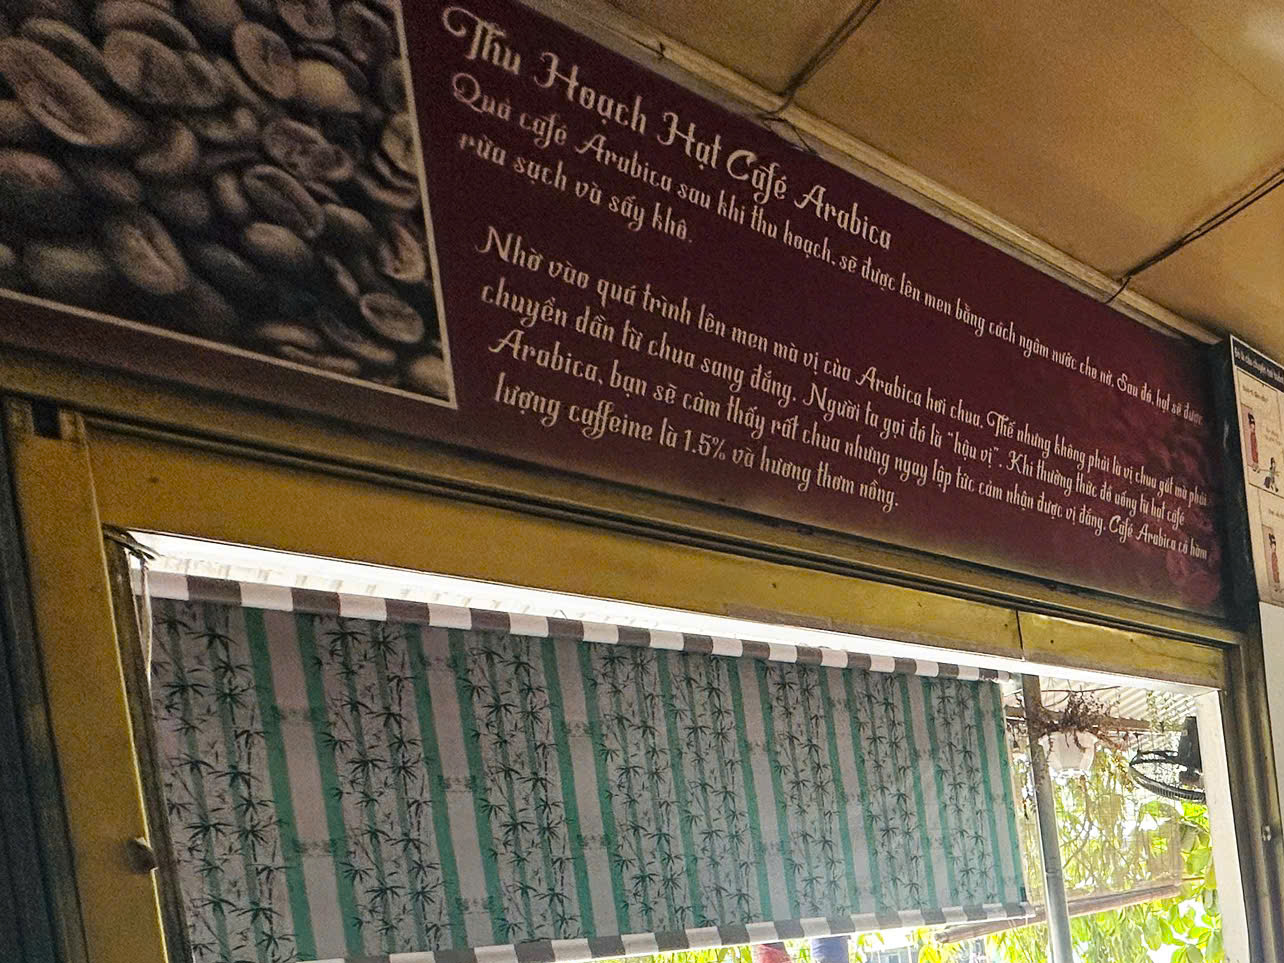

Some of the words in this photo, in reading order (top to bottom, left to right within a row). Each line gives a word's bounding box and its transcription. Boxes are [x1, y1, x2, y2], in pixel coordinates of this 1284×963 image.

[441, 5, 521, 76] Thu
[533, 51, 647, 135] Hoạch
[656, 111, 722, 170] Hạt
[726, 149, 787, 205] Café
[793, 184, 892, 250] Arabica
[451, 72, 512, 122] Quả
[519, 113, 567, 149] café
[575, 133, 673, 193] Arabica
[677, 183, 711, 210] sau
[717, 189, 746, 225] khi
[750, 204, 778, 239] thu
[839, 255, 858, 273] sẽ
[861, 256, 896, 291] được
[899, 272, 921, 302] lên
[924, 292, 952, 316] men
[955, 297, 986, 337] bằng
[988, 321, 1016, 344] cách
[459, 134, 507, 166] rửa
[513, 156, 567, 191] sạch
[575, 181, 602, 206] và
[608, 195, 645, 232] sấy
[651, 201, 692, 243] khô.
[479, 225, 544, 272] Nhờ
[548, 260, 590, 289] vào
[596, 278, 637, 308] quá
[642, 283, 692, 325] trình
[697, 303, 726, 338] lên
[731, 326, 768, 353] men
[773, 341, 799, 364] mà
[803, 351, 819, 376] vị
[823, 358, 851, 382] của
[855, 366, 922, 407] Arabica
[925, 386, 946, 415] hơi
[949, 398, 984, 429] chua.
[986, 410, 1016, 439] Thế
[481, 277, 568, 328] chuyển
[575, 305, 615, 343] dần
[621, 319, 644, 352] từ
[647, 331, 696, 369] chua
[700, 357, 745, 393] sang
[749, 364, 797, 408] đắng.
[802, 382, 861, 422] Người
[864, 400, 879, 428] ta
[879, 417, 906, 440] gọi
[909, 417, 926, 443] đó
[929, 422, 943, 449] là
[494, 371, 561, 427] lượng
[568, 399, 653, 441] caffeine
[659, 417, 678, 448] là
[684, 429, 726, 461] 1.5%
[731, 446, 755, 469] và
[759, 445, 812, 492] hương
[816, 460, 855, 495] thơm
[859, 479, 899, 513] nồng.
[609, 359, 648, 398] bạn
[652, 383, 677, 404] sẽ
[682, 391, 721, 418] cảm
[726, 395, 766, 440] thấy
[770, 414, 799, 441] rất
[802, 420, 841, 453] chua
[844, 433, 891, 476] nhưng
[894, 456, 928, 487] ngay
[932, 458, 952, 493] lập
[955, 465, 975, 492] tức
[978, 479, 1003, 501] cảm
